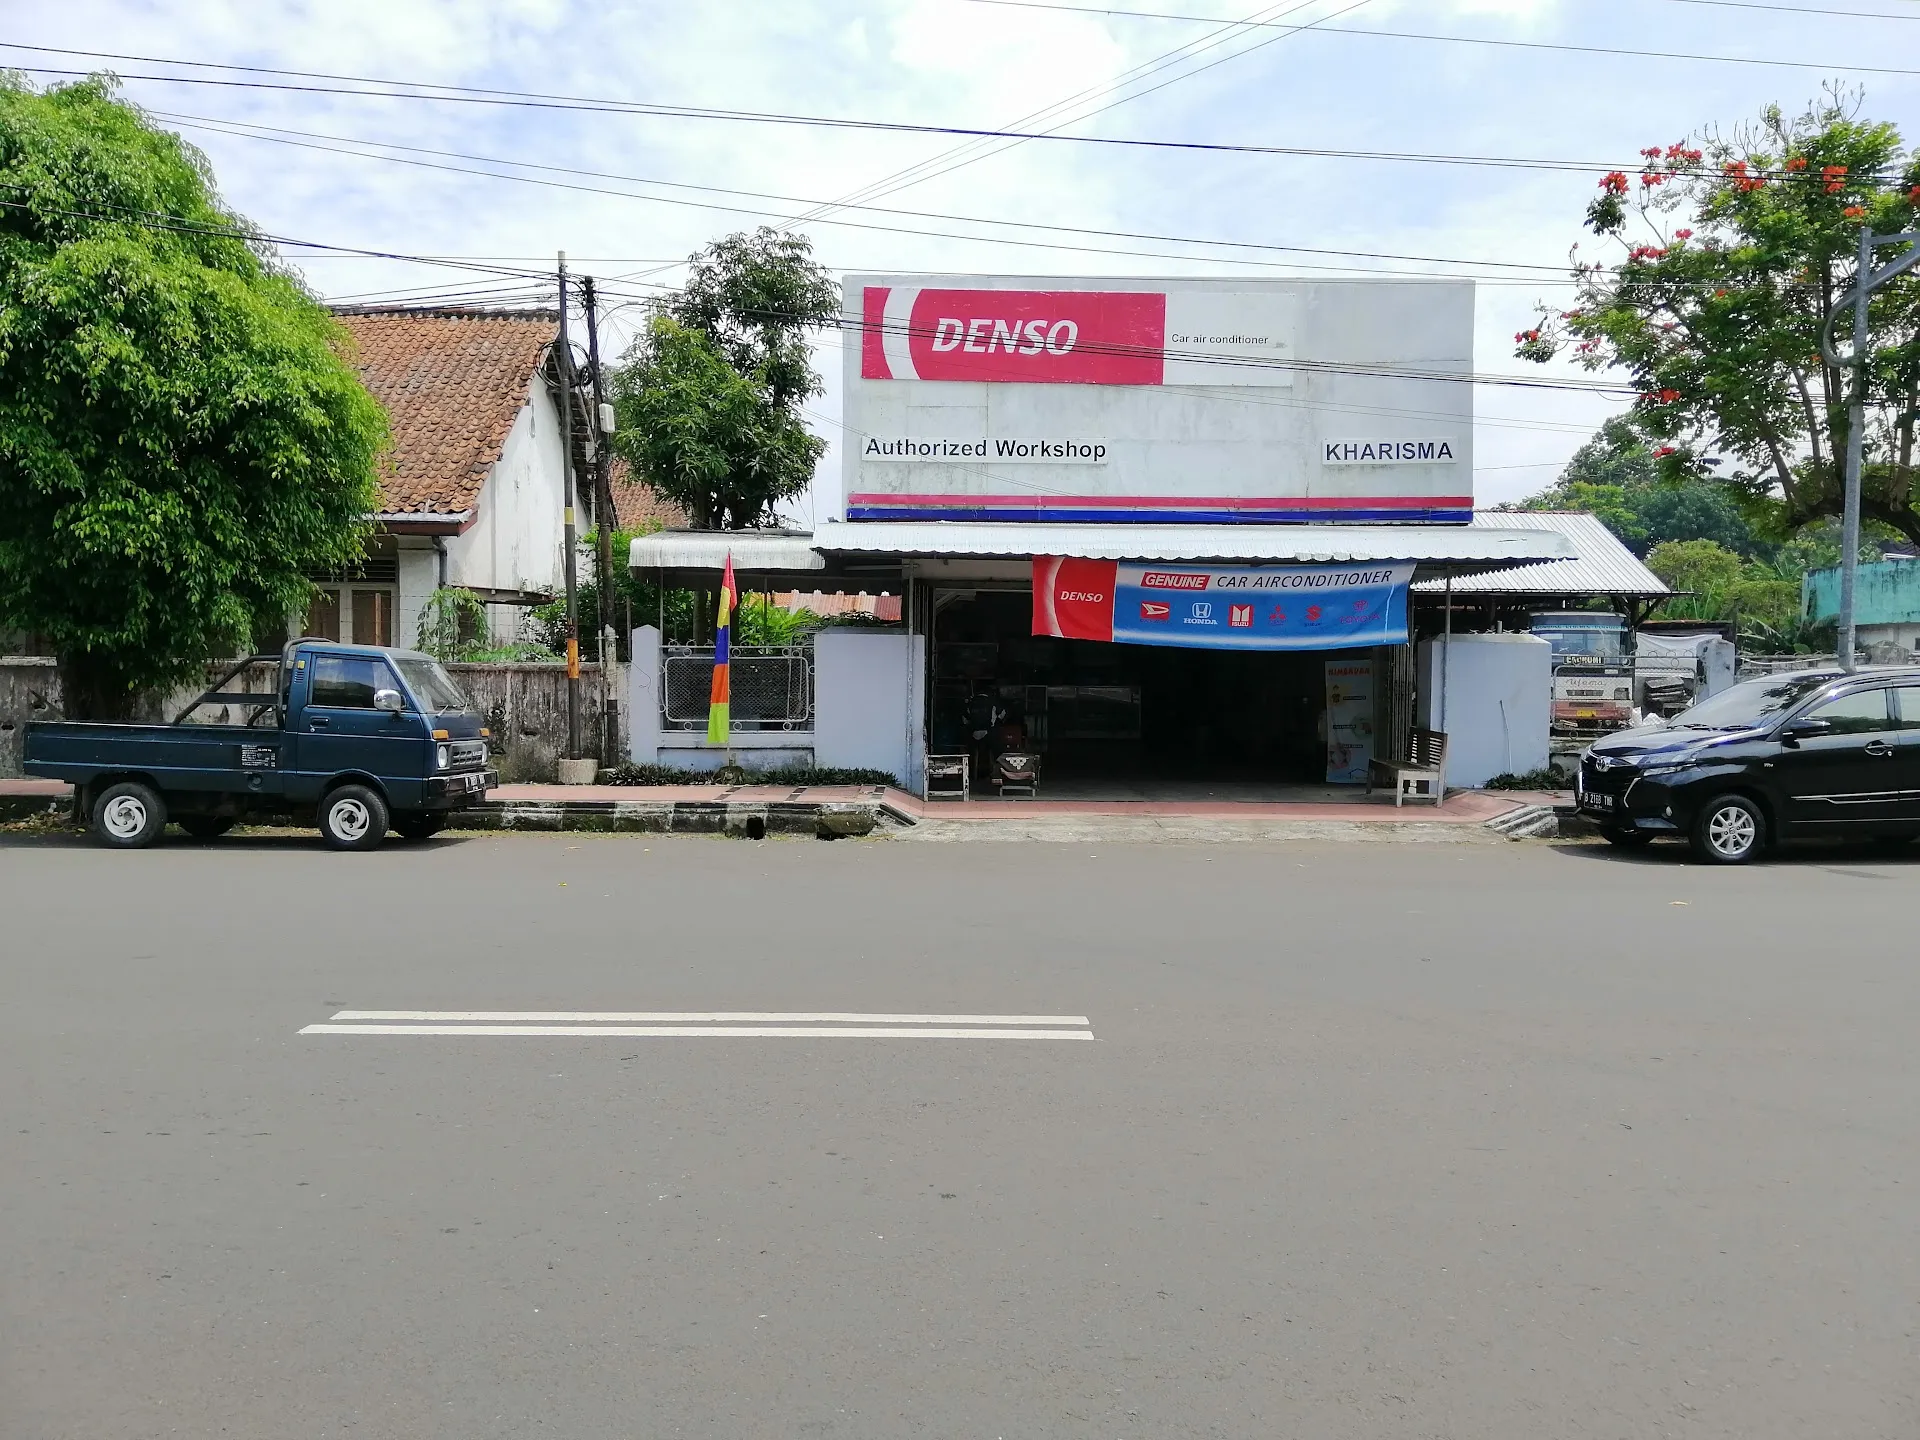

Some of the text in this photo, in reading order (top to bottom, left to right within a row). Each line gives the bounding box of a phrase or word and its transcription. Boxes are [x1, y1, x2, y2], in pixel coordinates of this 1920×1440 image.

[931, 317, 1078, 356] DENSO
[1171, 333, 1269, 345] Car air conditioner
[865, 438, 1107, 462] Authorized Workshop
[1326, 442, 1453, 461] KHARISMA
[1144, 570, 1393, 589] GENUINE CAR AIRCONDITIONER
[1060, 590, 1104, 603] DENSO
